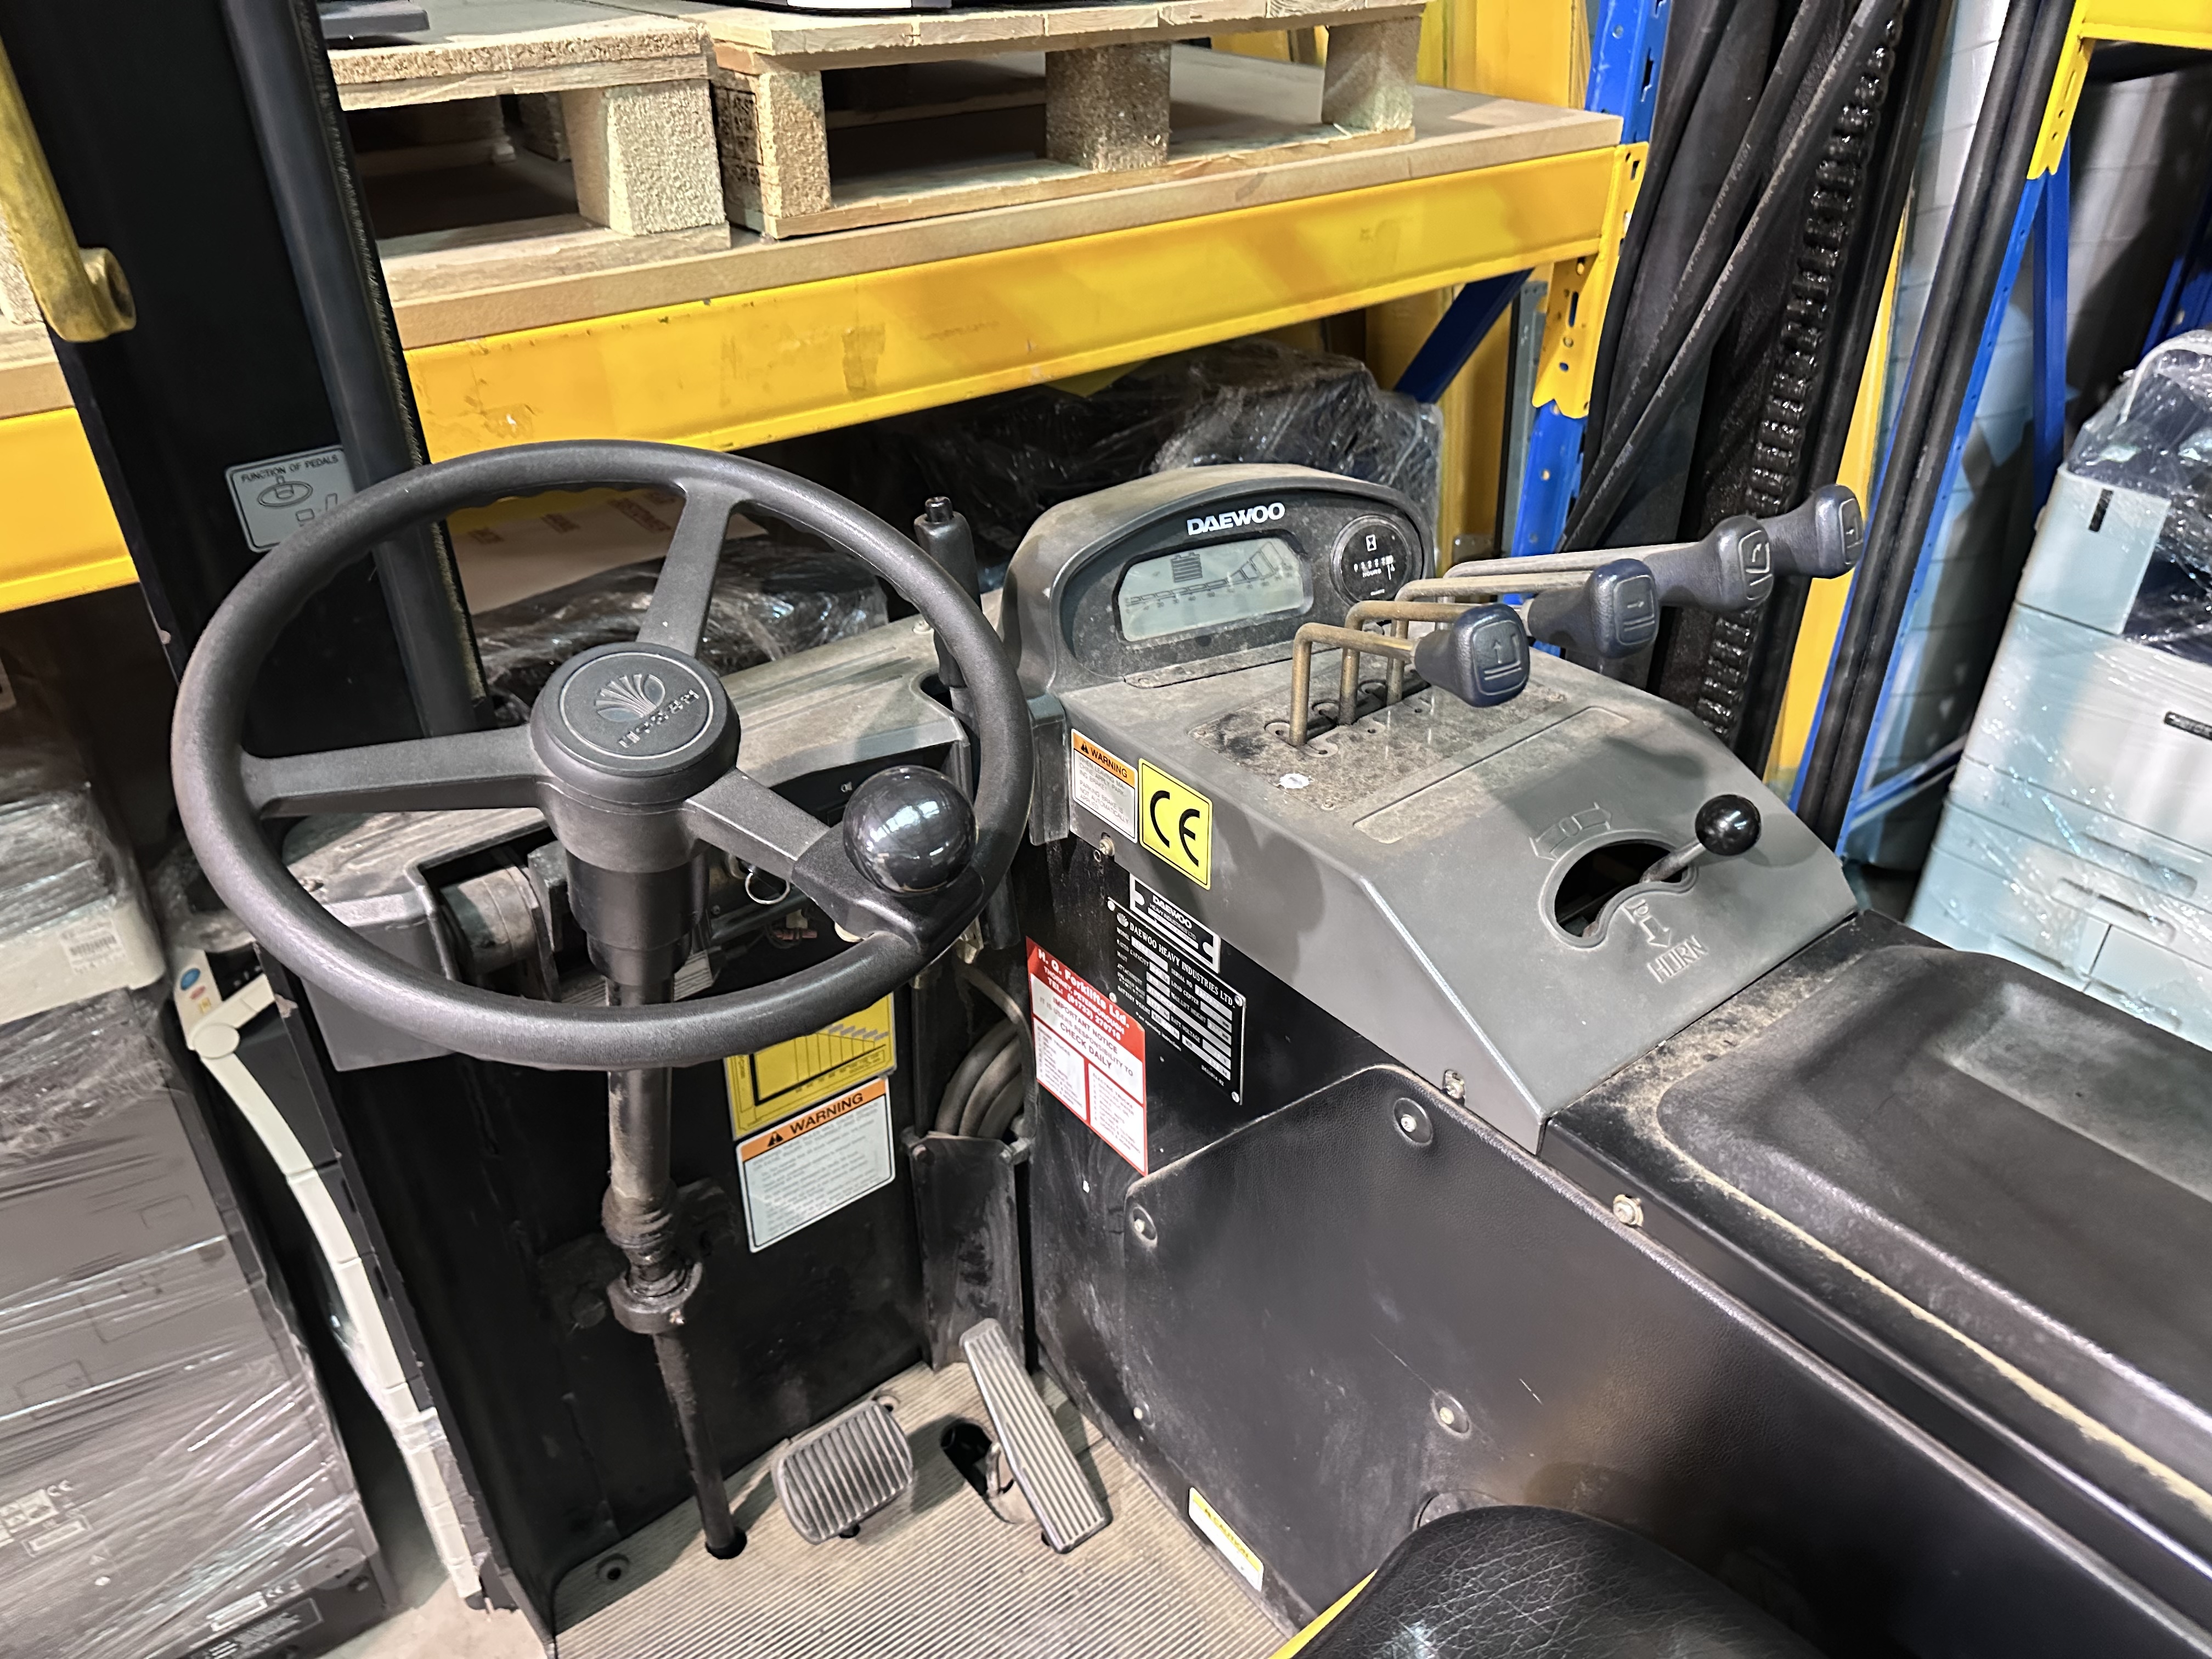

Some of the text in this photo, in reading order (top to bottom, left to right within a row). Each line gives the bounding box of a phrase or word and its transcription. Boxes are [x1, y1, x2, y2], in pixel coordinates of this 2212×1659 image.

[241, 455, 338, 483] FUNCTION OF PEDALS
[1187, 503, 1285, 535] DAEWOO
[1091, 747, 1127, 778] WARNING
[1080, 779, 1099, 798] PARKING
[1101, 794, 1116, 810] BRAKE
[1080, 786, 1128, 825] NOT AUTOMATICALLY
[1150, 790, 1200, 867] CE
[1149, 902, 1163, 917] HEAVY
[1164, 912, 1187, 934] INDUSTRIES
[1153, 894, 1192, 930] DAEWOO
[1130, 921, 1156, 949] DAEWOO
[1159, 943, 1180, 967] HEAVY
[1181, 960, 1218, 996] INDUSTRIES
[1220, 990, 1235, 1009] LTD.
[1171, 967, 1185, 983] SERIAL
[1647, 934, 1709, 983] HORN
[1038, 948, 1048, 966] H.
[1051, 957, 1062, 976] Q.
[1064, 968, 1107, 1011] Forklifts
[1109, 1003, 1130, 1030] Ltd.
[1043, 964, 1073, 995] THORNEY,
[1073, 988, 1124, 1036] PETERBOROUGH
[1047, 976, 1063, 995] TEL:
[1052, 996, 1117, 1054] IMPORTANT NOTICE
[1053, 1007, 1072, 1028] USERS
[1074, 1023, 1122, 1068] RESPONSIBILITY
[1125, 1065, 1133, 1077] TO
[1060, 1021, 1111, 1070] CHECK DAILY
[790, 1092, 862, 1136] WARNING
